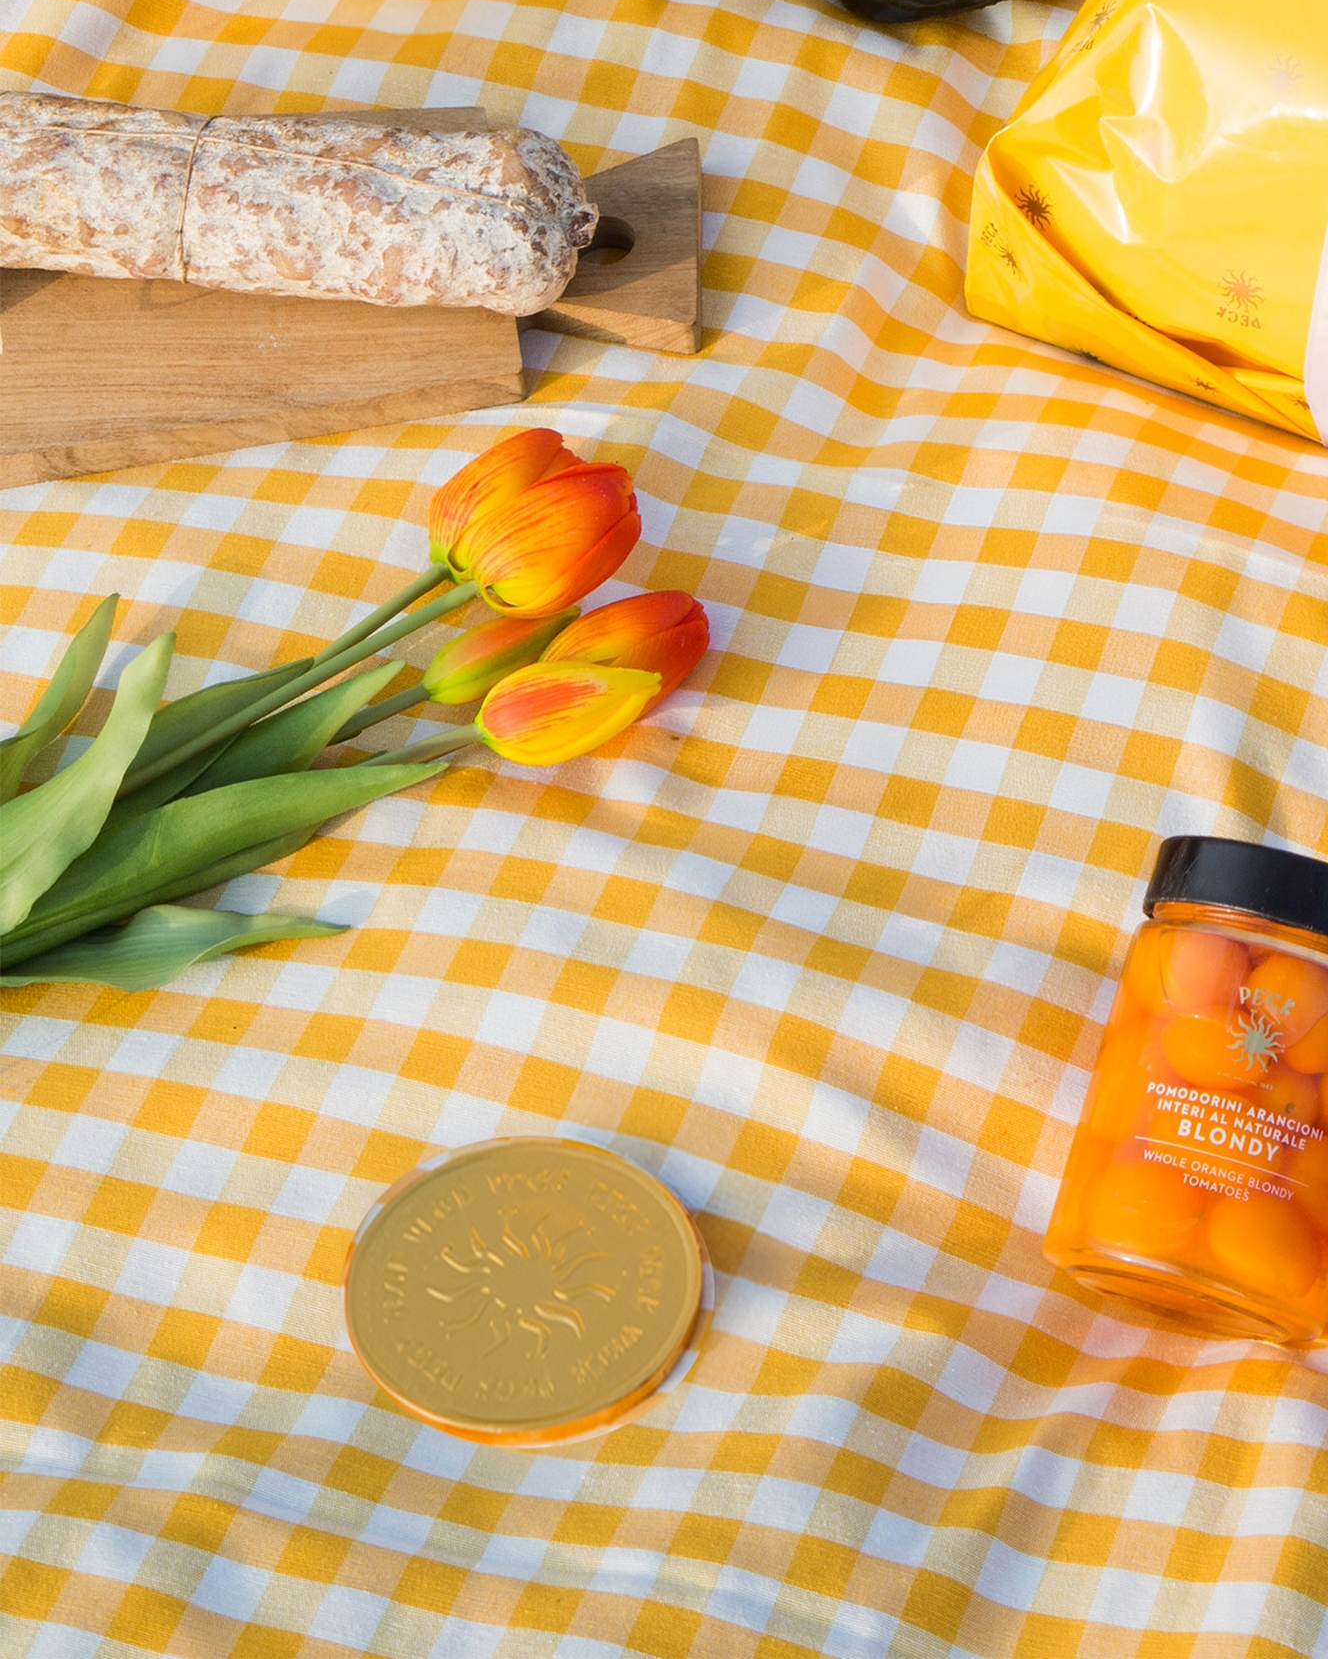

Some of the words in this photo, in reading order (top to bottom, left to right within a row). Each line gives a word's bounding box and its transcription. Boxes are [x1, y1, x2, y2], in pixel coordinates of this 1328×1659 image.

[1216, 306, 1261, 329] PECK
[1147, 1081, 1242, 1114] POMODORINI
[1247, 1107, 1324, 1141] ARANCIONI
[1157, 1099, 1205, 1119] INTERI
[1210, 1111, 1228, 1125] AL
[1234, 1117, 1306, 1151] NATURALE
[1178, 1119, 1280, 1162] BLONDY
[1143, 1149, 1187, 1170] WHOLE
[1191, 1161, 1244, 1185] ORANGE
[1247, 1177, 1295, 1201] BLONDY
[1183, 1172, 1250, 1203] TOMATOES
